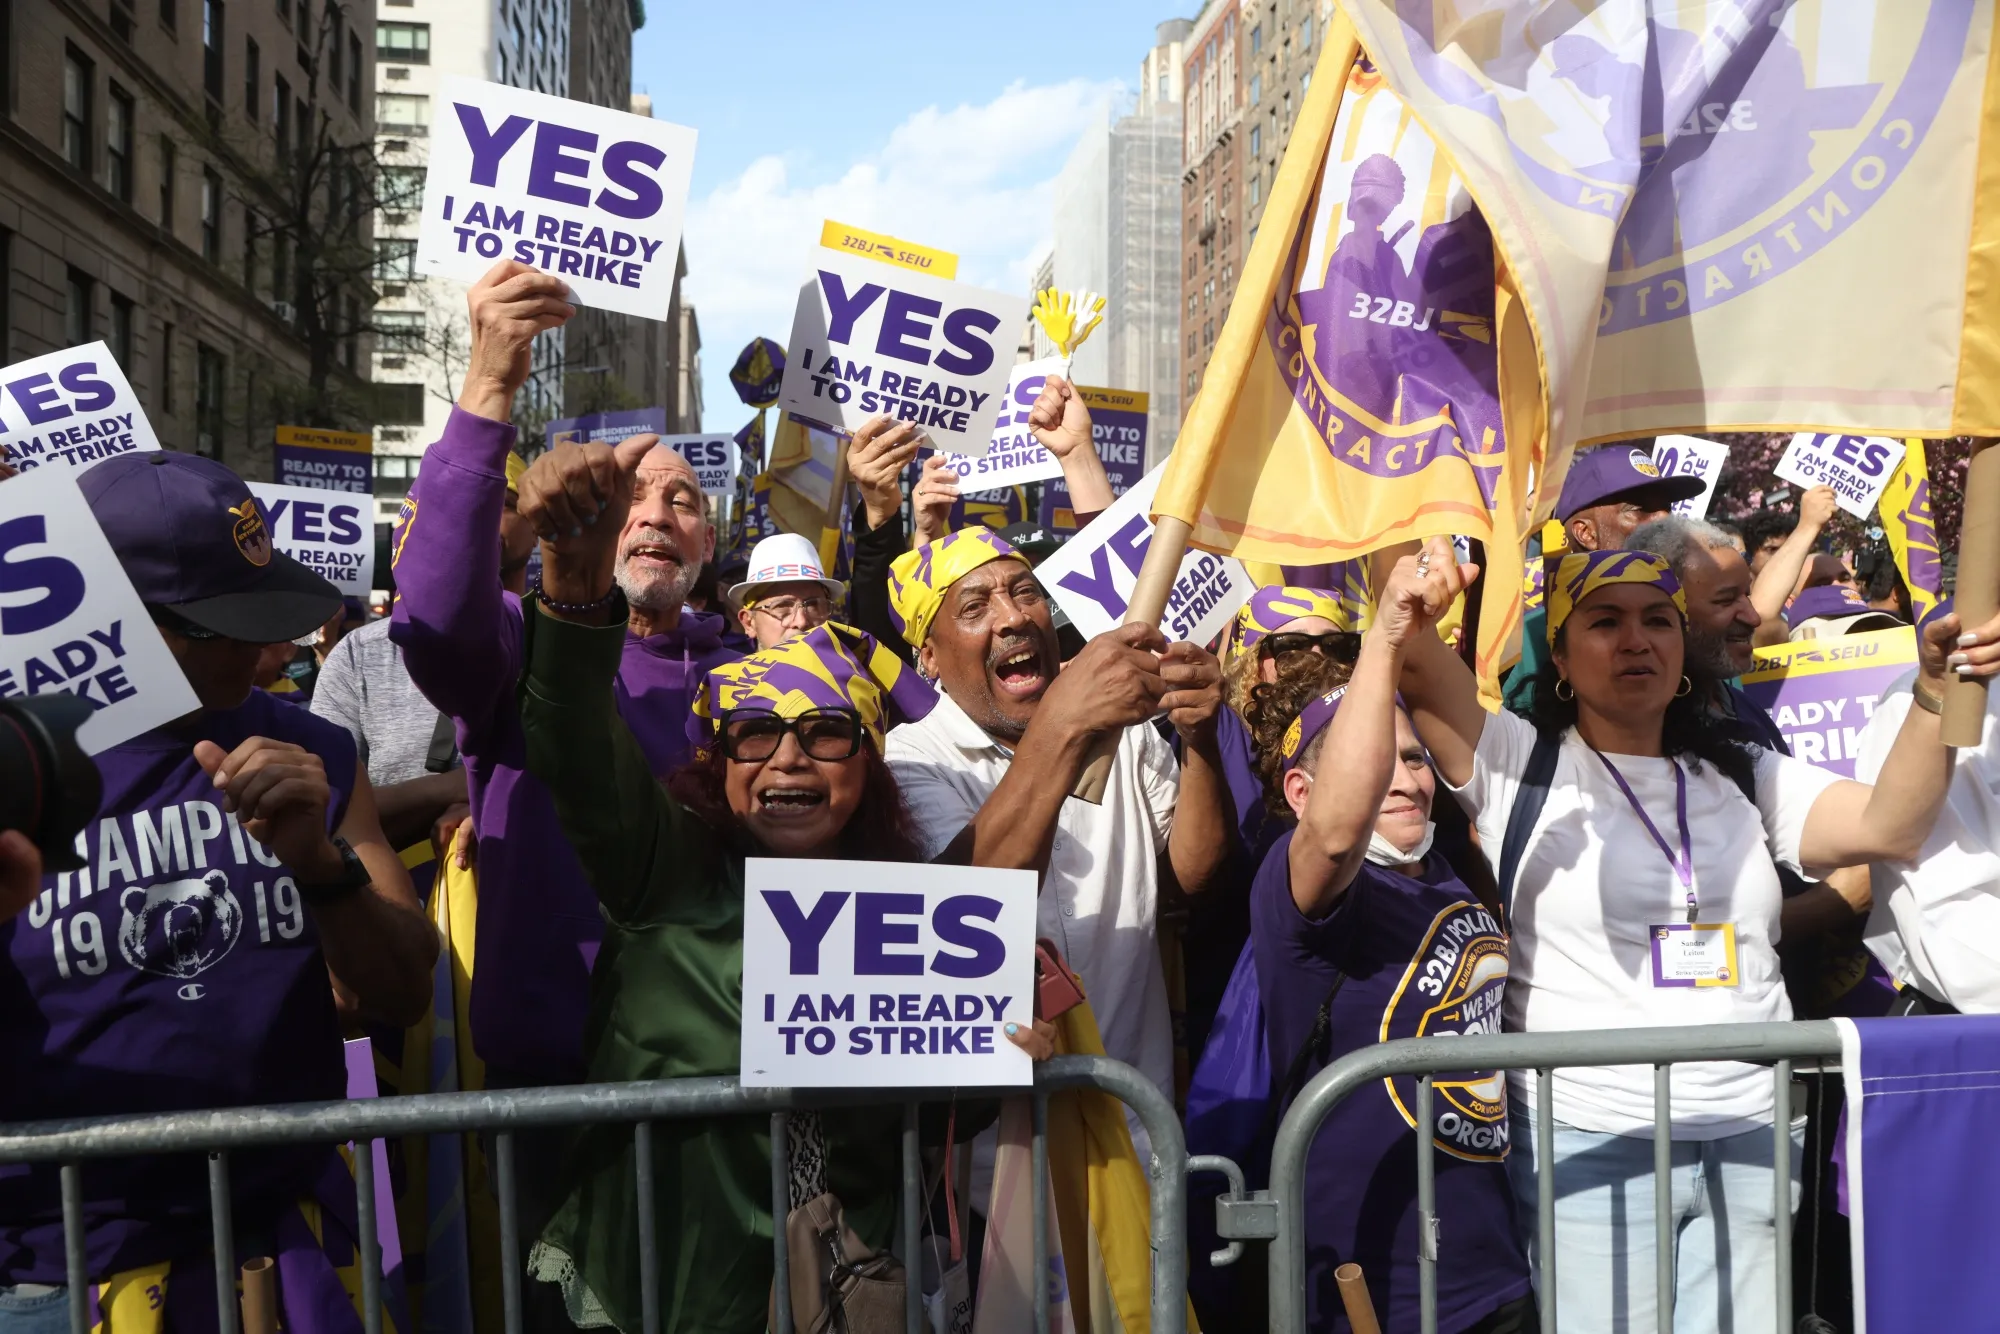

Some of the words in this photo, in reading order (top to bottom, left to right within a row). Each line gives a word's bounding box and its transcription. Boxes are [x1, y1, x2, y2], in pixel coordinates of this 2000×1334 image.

[452, 101, 668, 220] YES
[442, 195, 455, 221] I
[463, 201, 525, 235] AM
[535, 214, 663, 263] READY
[453, 226, 503, 258] TO
[512, 239, 644, 289] STRIKE
[841, 235, 875, 253] 32BJ
[897, 250, 933, 269] SEIU
[817, 269, 1001, 376] YES
[1348, 292, 1435, 332] 32BJ
[802, 348, 814, 370] I
[819, 355, 872, 387] AM
[879, 370, 990, 412] READY
[1277, 324, 1429, 471] CONTRACT
[810, 374, 852, 404] TO
[859, 390, 971, 433] STRIKE
[1110, 395, 1134, 406] SEIU
[48, 412, 133, 450] READY
[589, 424, 654, 437] RESIDENTIAL
[988, 432, 1040, 455] READ
[1118, 427, 1140, 442] TO
[282, 459, 339, 477] READY
[342, 465, 366, 479] TO
[696, 469, 730, 480] EADY
[977, 447, 1048, 474] STRIKE
[1106, 472, 1124, 484] UR
[1794, 447, 1802, 457] I
[1803, 452, 1828, 470] AM
[1829, 464, 1876, 495] READY
[700, 479, 726, 488] RIKE
[1795, 460, 1815, 476] TO
[1817, 472, 1865, 504] STRIKE
[254, 496, 362, 546] YES
[299, 548, 366, 567] READY
[304, 566, 358, 582] RIKE
[1056, 512, 1154, 621] YE
[1171, 569, 1233, 641] STRIKE
[1829, 643, 1879, 661] SEIU
[1764, 698, 1848, 729] ADY
[51, 911, 108, 980] 19
[253, 875, 305, 943] 19
[759, 889, 1006, 979] YES
[1417, 933, 1460, 997] 32BJ
[1446, 911, 1504, 943] POLITI
[1458, 952, 1477, 990] BUILDING
[764, 993, 775, 1022] I
[787, 993, 855, 1022] AM
[869, 993, 1013, 1022] READY
[1462, 996, 1483, 1022] WE
[778, 1026, 836, 1055] TO
[848, 1026, 995, 1055] STRIKE
[1437, 1112, 1510, 1150] ORGAN
